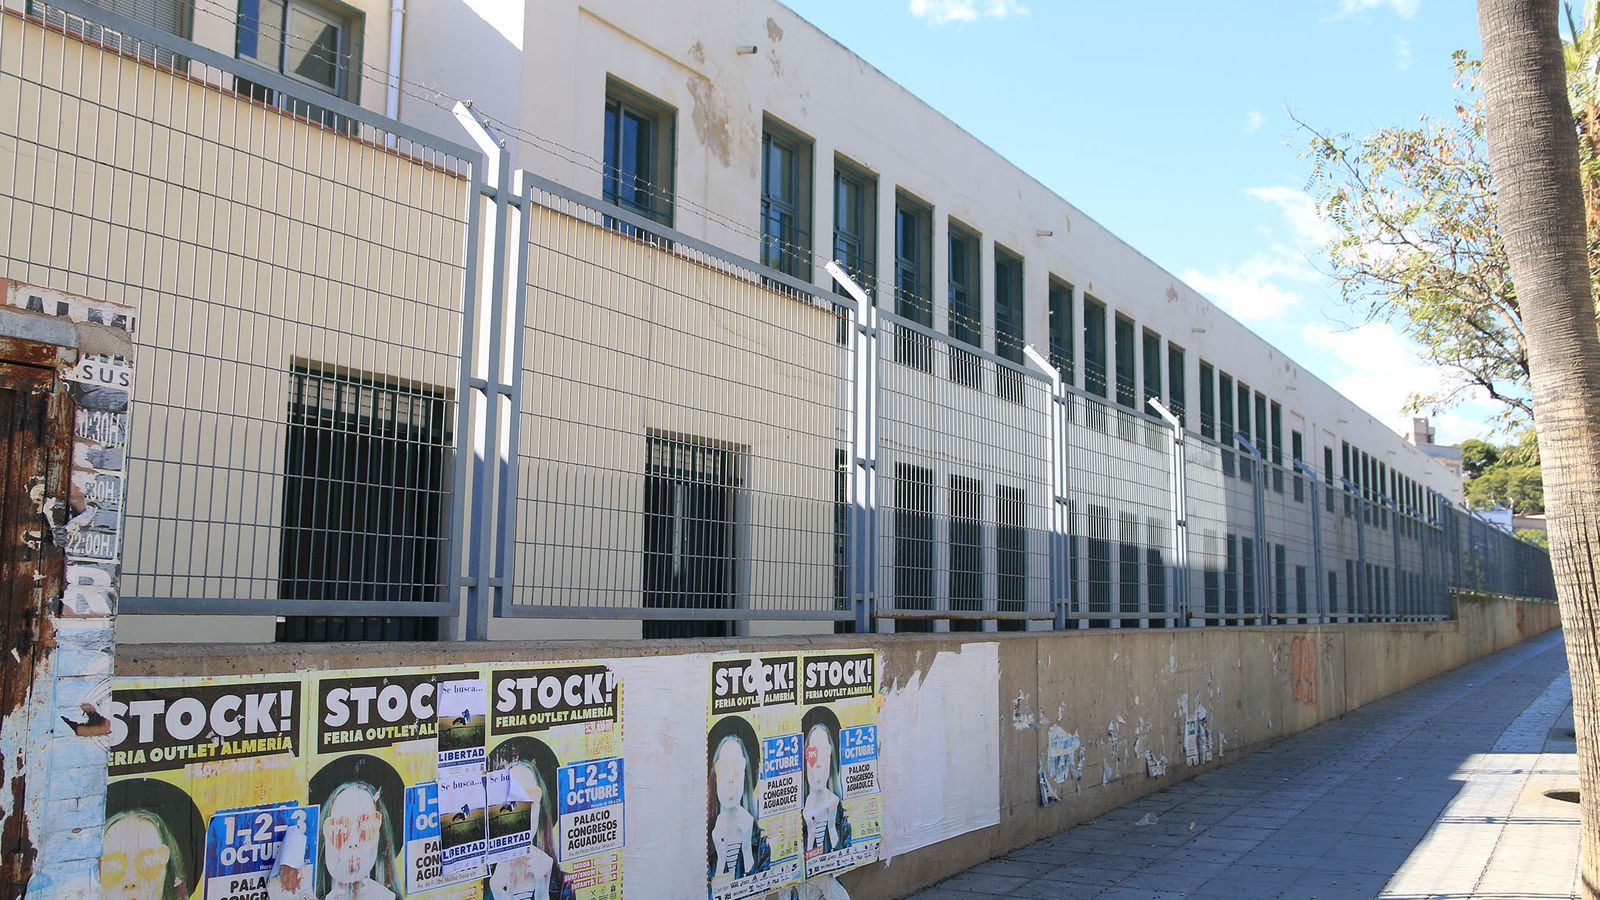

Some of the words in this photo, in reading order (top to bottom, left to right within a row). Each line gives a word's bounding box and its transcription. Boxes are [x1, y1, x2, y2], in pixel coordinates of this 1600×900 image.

[82, 365, 130, 387] SUS
[805, 658, 872, 688] STOCK!
[496, 671, 614, 712] STOCK!
[714, 697, 737, 709] FERIA
[736, 695, 760, 707] OUTLE
[764, 689, 795, 704] ALMERÍA
[805, 690, 824, 700] FERIA
[824, 687, 848, 698] OUTLET
[847, 684, 873, 695] ALMERÍA
[324, 683, 435, 727] STOC
[109, 690, 293, 747] STOCK!
[495, 715, 528, 728] FERIA
[528, 711, 569, 725] OUTLET
[570, 704, 613, 720] ALMERÍA
[323, 729, 364, 745] FERIA
[366, 724, 418, 741] OUTLET
[845, 726, 875, 747] 1-2-3
[108, 750, 146, 767] ERIA
[150, 741, 217, 763] OUTLET
[220, 733, 293, 756] ALMERÍA
[438, 748, 485, 762] LIBERTAD
[763, 736, 799, 759] 1-2-3
[845, 743, 875, 759] OCTUBRE
[764, 755, 799, 772] OCTUBRE
[848, 764, 870, 774] PALACIO
[567, 761, 618, 789] 1-2-3
[767, 777, 793, 790] PALACIO
[845, 772, 874, 783] CONGRESOS
[567, 783, 619, 806] OCTUBRE
[763, 785, 798, 800] CONGRESOS
[846, 780, 874, 792] AGUADULCE
[763, 794, 797, 810] AGUADULCE
[574, 810, 610, 826] PALACIO
[568, 820, 618, 839] CONGRESOS
[489, 832, 531, 849] LIBERTAD
[568, 831, 617, 850] AGUADULCE
[220, 842, 277, 866] OCTU
[443, 841, 486, 860] LBERTAD
[230, 876, 267, 893] PALA
